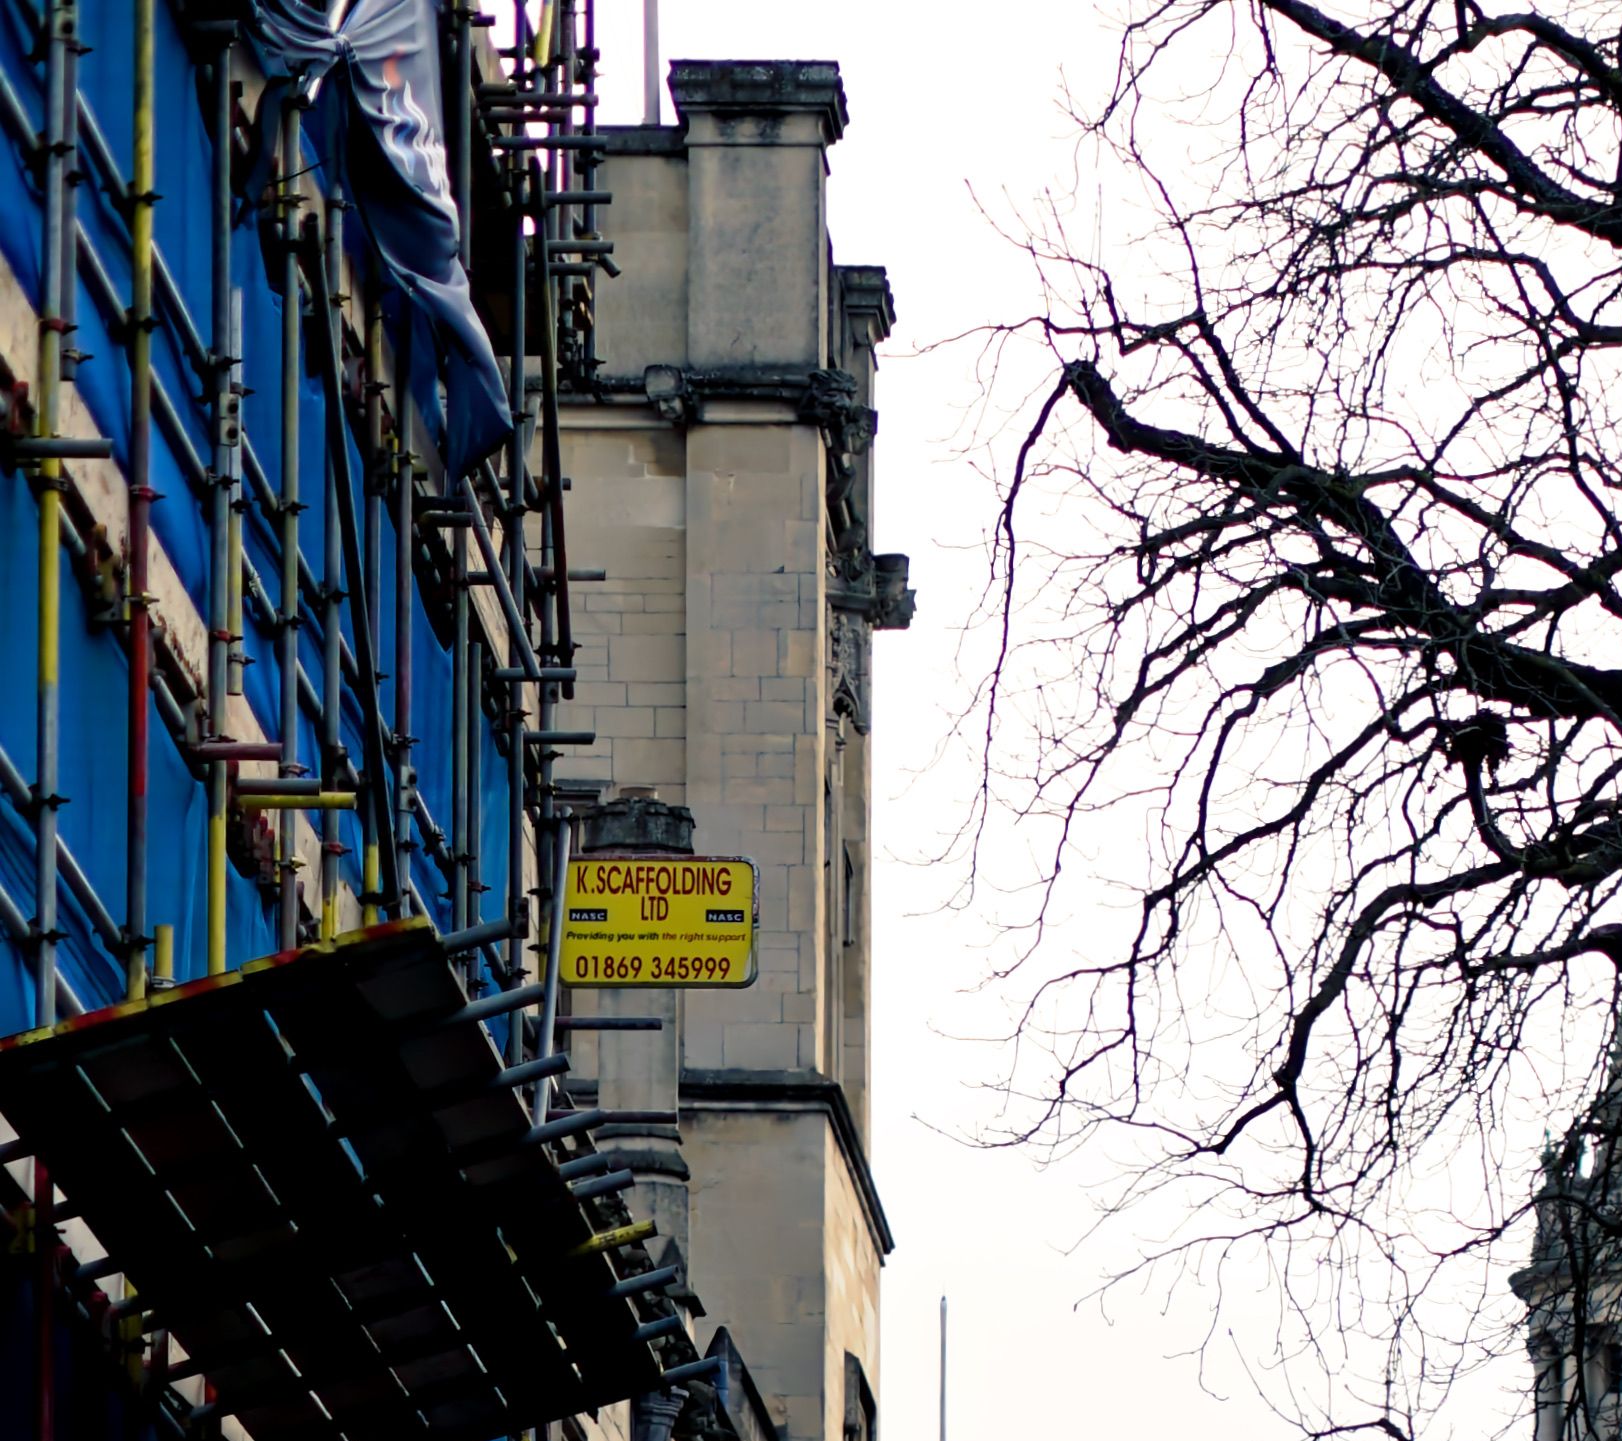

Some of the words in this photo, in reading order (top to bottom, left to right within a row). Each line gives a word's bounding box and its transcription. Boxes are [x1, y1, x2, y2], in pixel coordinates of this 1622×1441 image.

[640, 896, 669, 921] LTD
[571, 912, 606, 921] NASC
[707, 913, 743, 922] NASC
[566, 931, 614, 942] Providing
[617, 932, 635, 942] you
[638, 931, 660, 941] with
[662, 932, 677, 941] the
[680, 932, 704, 943] right
[706, 932, 747, 943] support
[575, 955, 643, 979] 01869
[650, 956, 731, 980] 345999
